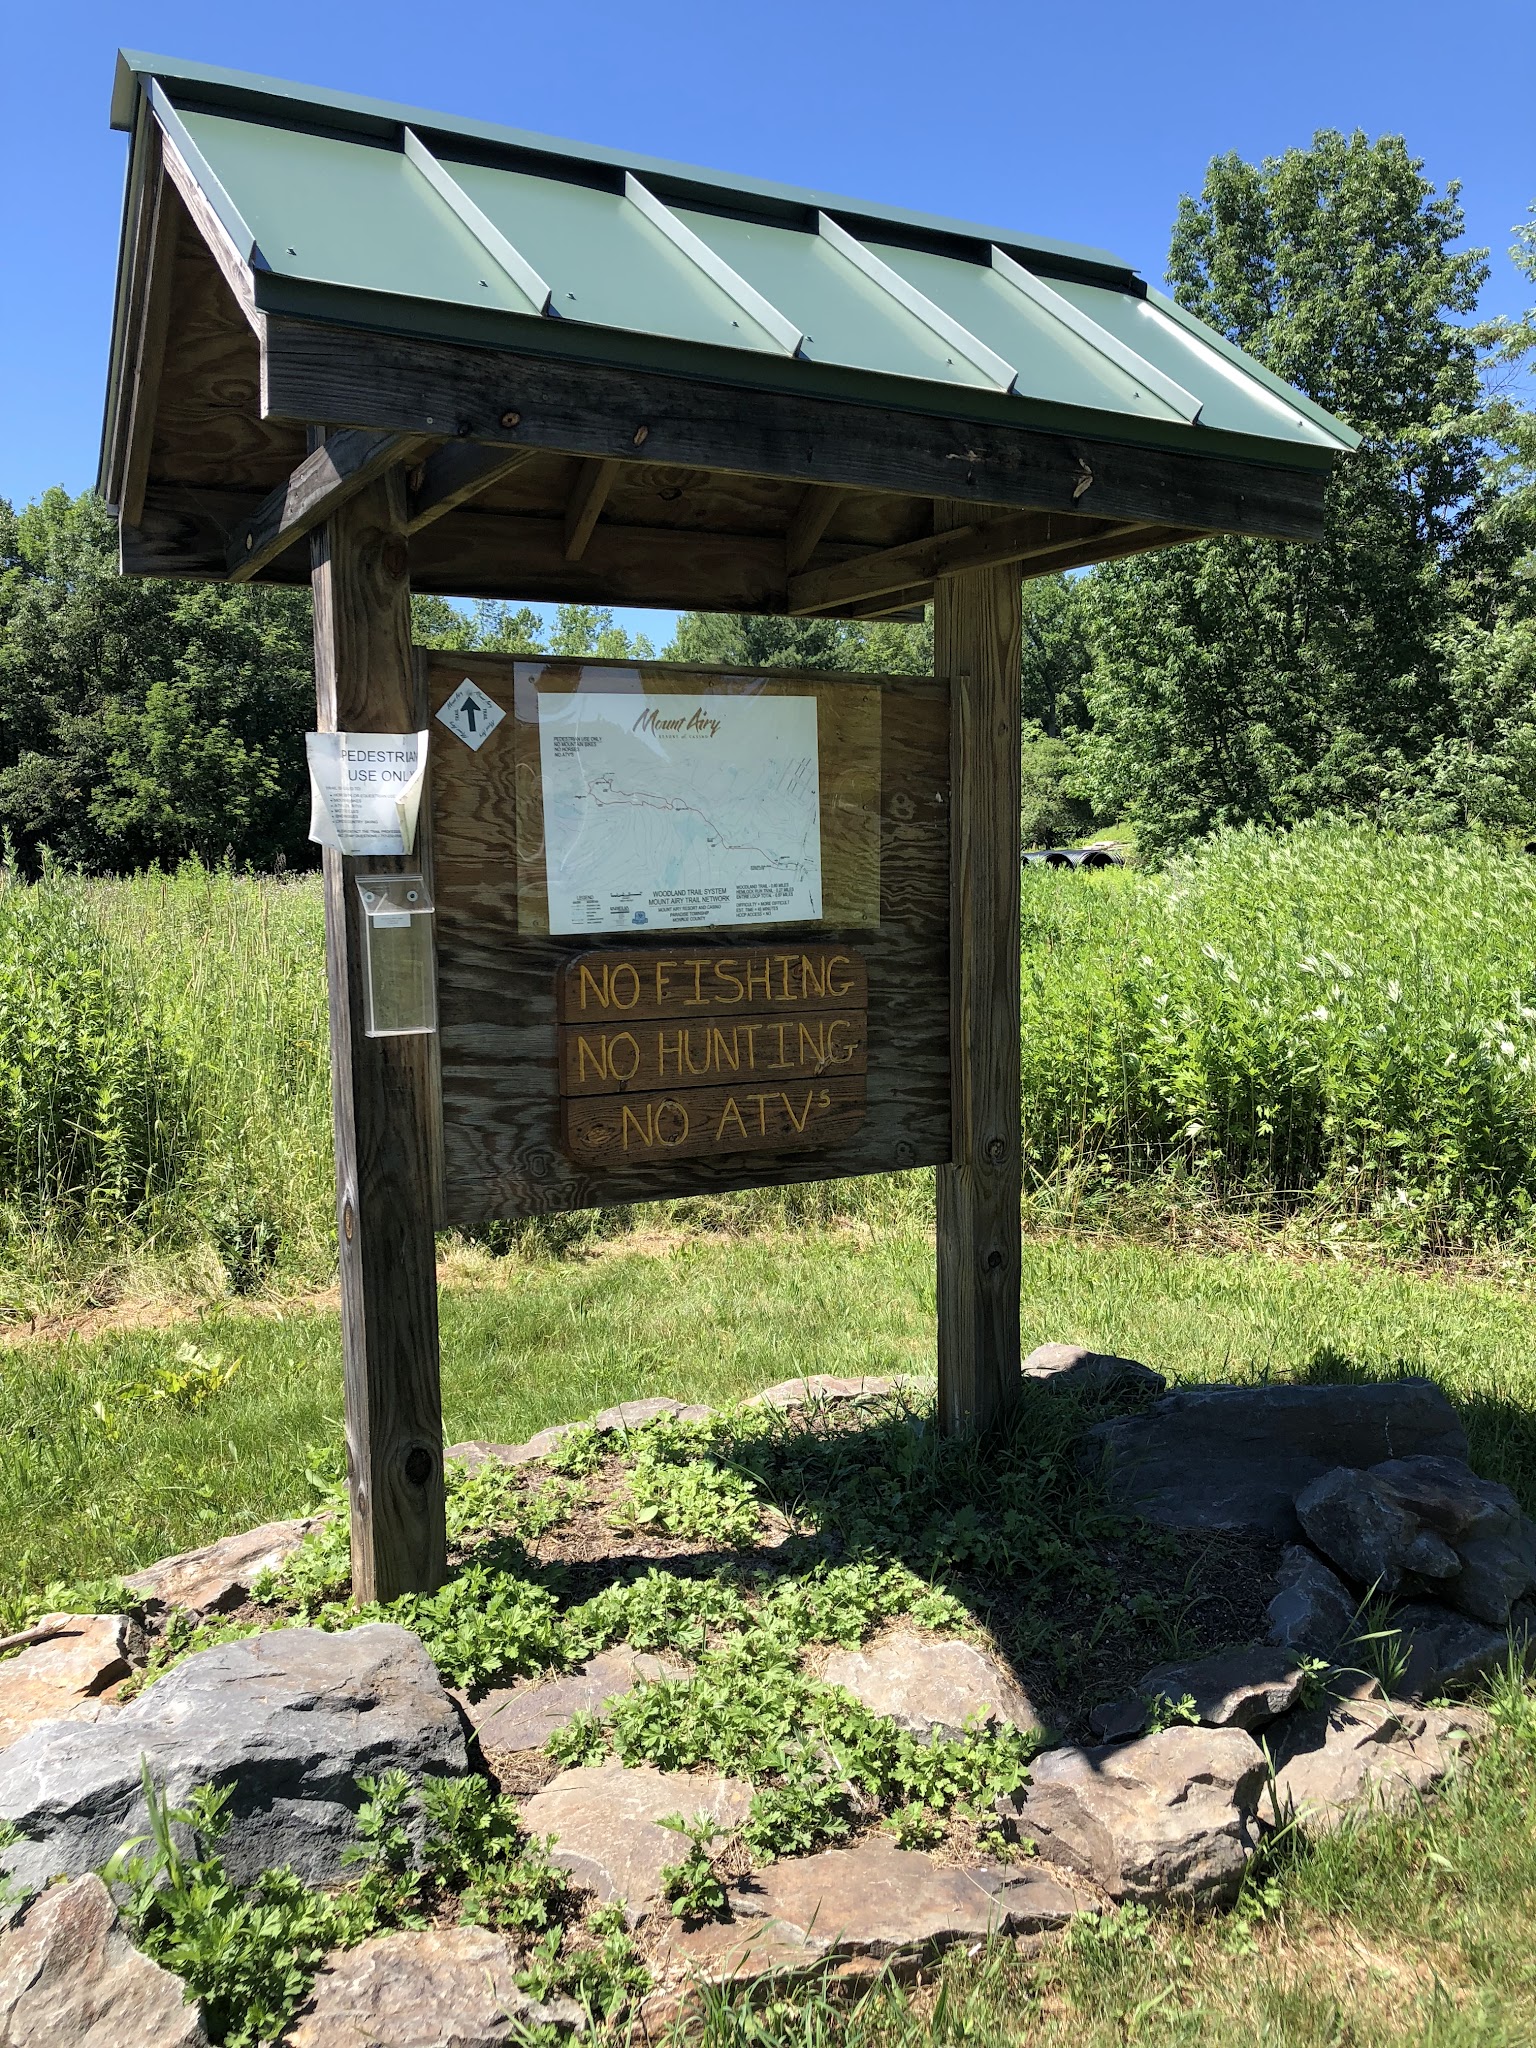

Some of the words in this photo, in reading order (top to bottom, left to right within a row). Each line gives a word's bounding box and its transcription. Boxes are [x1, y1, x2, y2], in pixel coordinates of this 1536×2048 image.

[632, 708, 686, 737] Mount
[686, 707, 721, 738] Airy
[348, 769, 377, 781] USE
[648, 898, 670, 906] MOUNT
[670, 897, 684, 905] AIRY
[685, 896, 701, 904] TRAIL
[702, 895, 731, 903] NETWORK
[652, 889, 686, 898] WOODLAND
[687, 888, 703, 896] TRAIL
[703, 887, 727, 895] SYSTEM
[579, 962, 641, 1010] NO
[656, 954, 855, 1005] FISHING
[578, 1031, 641, 1082] NO
[658, 1020, 859, 1076] HUNTING
[622, 1098, 689, 1150] NO
